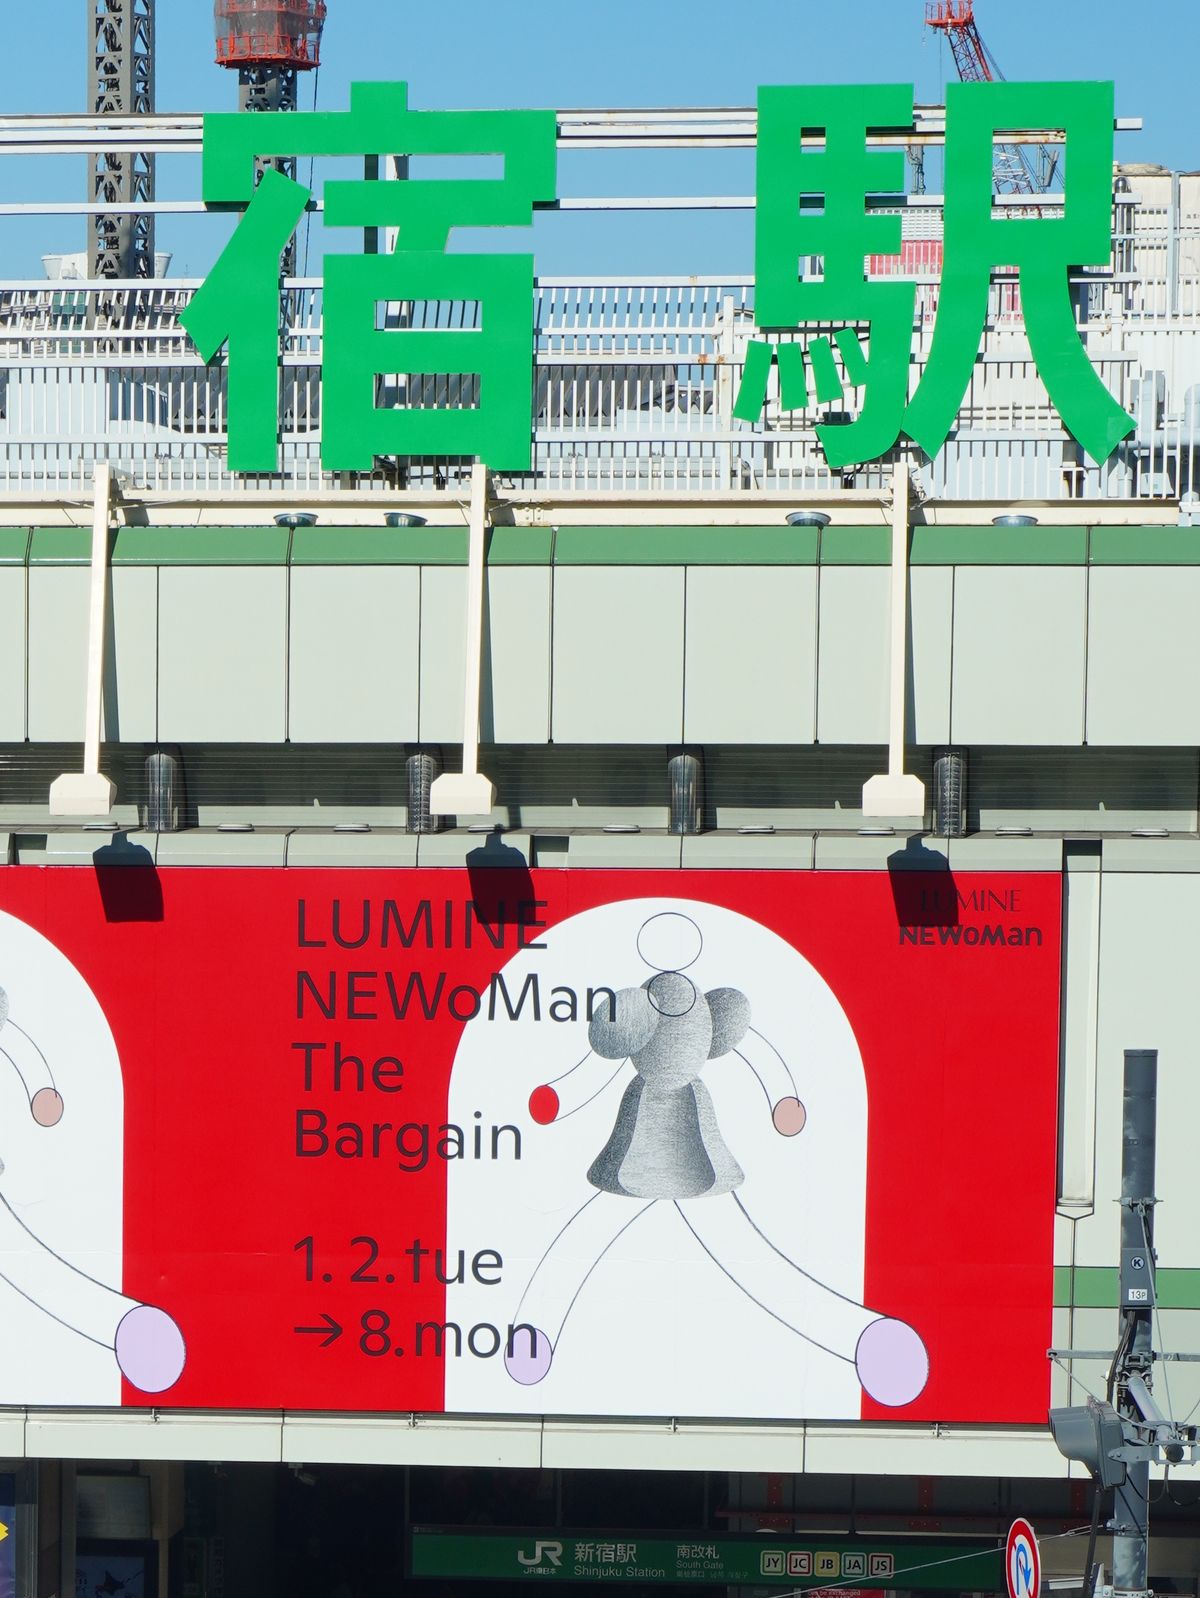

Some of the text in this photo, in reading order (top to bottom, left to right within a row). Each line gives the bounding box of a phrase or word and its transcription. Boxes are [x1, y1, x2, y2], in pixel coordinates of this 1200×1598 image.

[920, 889, 1022, 912] LUMINE
[296, 899, 548, 949] LUMINE
[898, 924, 1044, 946] NEWoMan
[296, 971, 617, 1022] NEWoMan
[292, 1042, 404, 1093] The
[295, 1112, 523, 1171] Bargain
[518, 1541, 720, 1566] JR 新宿駅 南改札
[766, 1558, 780, 1568] JY
[793, 1558, 807, 1569] JC
[820, 1559, 834, 1570] JB
[574, 1560, 723, 1579] Shinjuku Station South Gate
[847, 1560, 861, 1570] JA
[875, 1560, 887, 1571] JS
